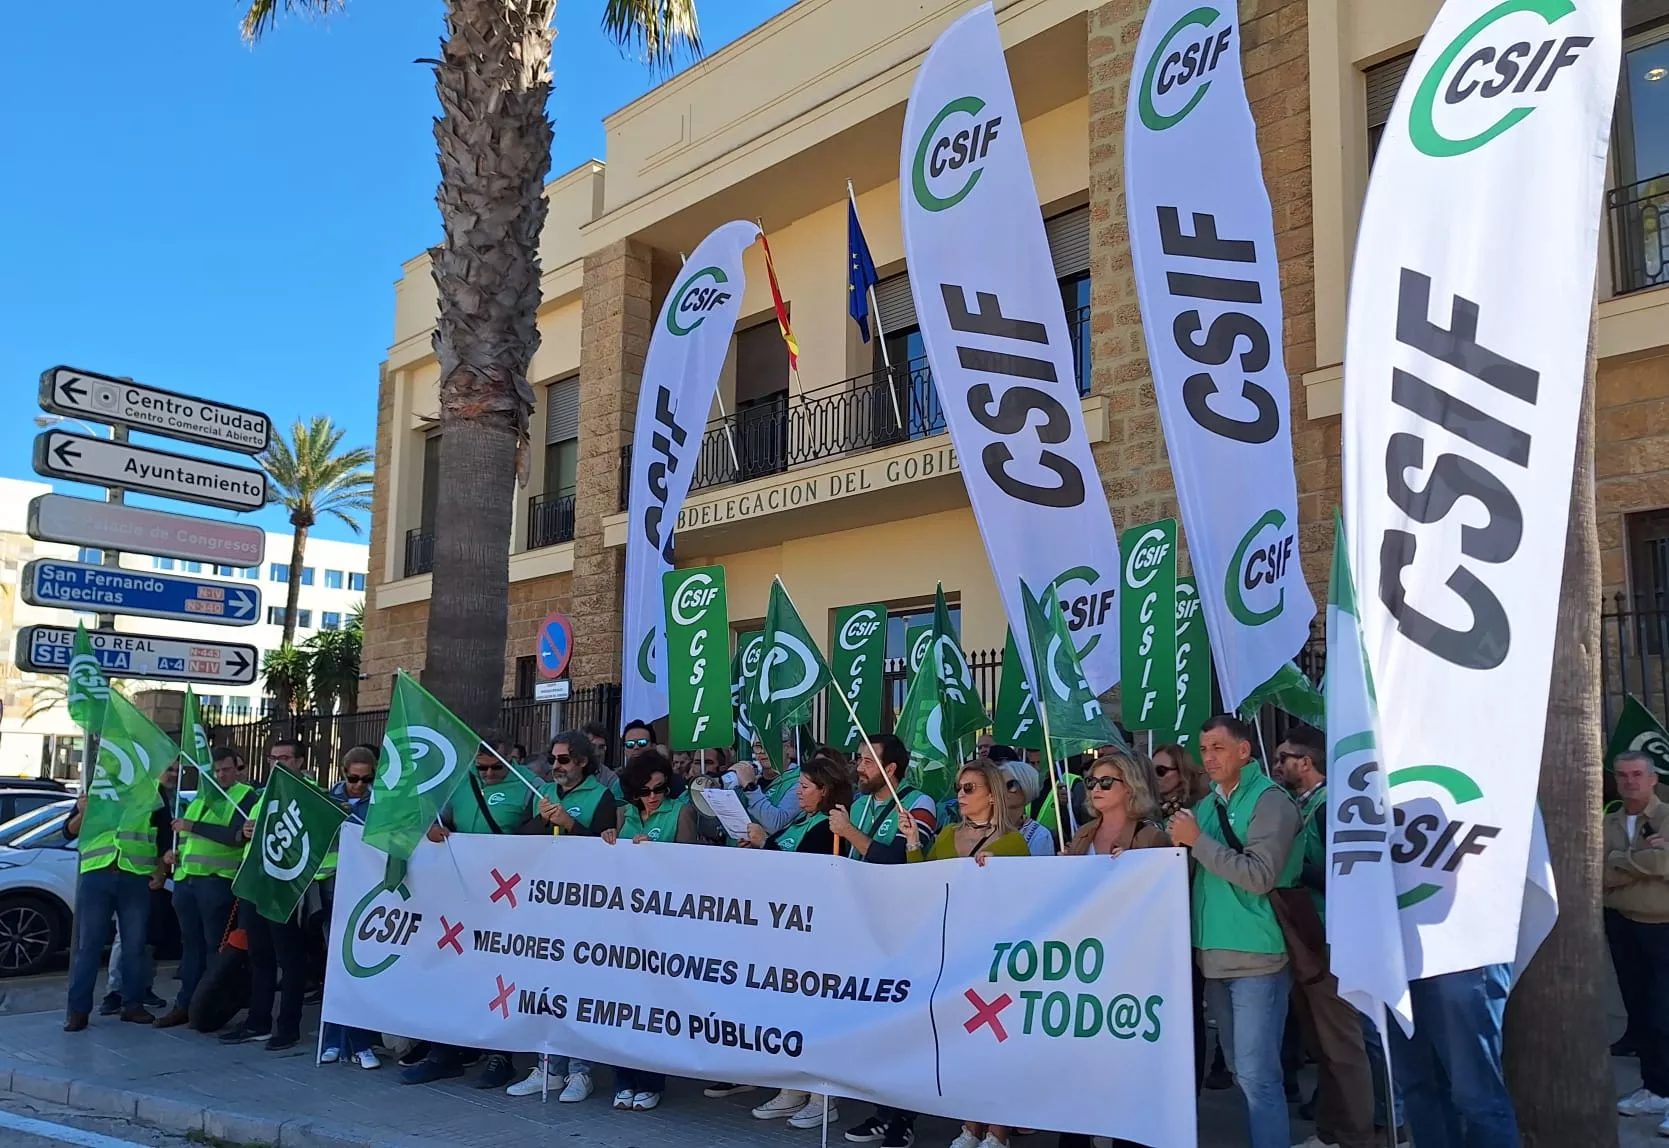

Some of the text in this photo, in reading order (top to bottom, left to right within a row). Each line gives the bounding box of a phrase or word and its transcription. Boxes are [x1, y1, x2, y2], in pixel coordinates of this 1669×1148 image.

[1157, 25, 1232, 96] CSIF
[1445, 35, 1594, 105] CSIF
[929, 116, 1002, 179] CSIF
[1157, 206, 1280, 444] CSIF
[125, 389, 264, 434] Centro Ciudad
[940, 282, 1085, 508] CSIF
[125, 407, 264, 445] Centro Comercial Abierto
[124, 458, 261, 497] Ayuntamiento
[677, 448, 959, 529] BDELEGACION DEL GOBIE
[1379, 267, 1540, 670] CSIF
[177, 529, 258, 553] Congresos
[1134, 543, 1169, 570] CSIF
[1244, 534, 1294, 591] CSIF
[39, 582, 123, 604] Algeciras
[42, 565, 165, 593] San Fernando
[680, 587, 720, 610] CSIF
[847, 620, 880, 639] CSIF
[1176, 598, 1201, 619] SIF
[36, 631, 155, 653] PUEO REAL
[37, 645, 128, 668] SELA
[159, 658, 184, 671] A-4
[1139, 592, 1157, 722] CSIF
[189, 660, 220, 673] N-IV
[689, 629, 710, 744] CSIF
[267, 799, 303, 862] CSIF
[357, 905, 422, 946] CSIF
[528, 879, 813, 932] ¡SUBIDA SALARIAL YA!
[473, 929, 911, 1003] MEJORES CONDICIONES LABORALES
[988, 937, 1105, 984] TODO
[518, 987, 804, 1058] MÁS EMPLEO PÚBLICO
[1019, 990, 1164, 1043] TOD@S
